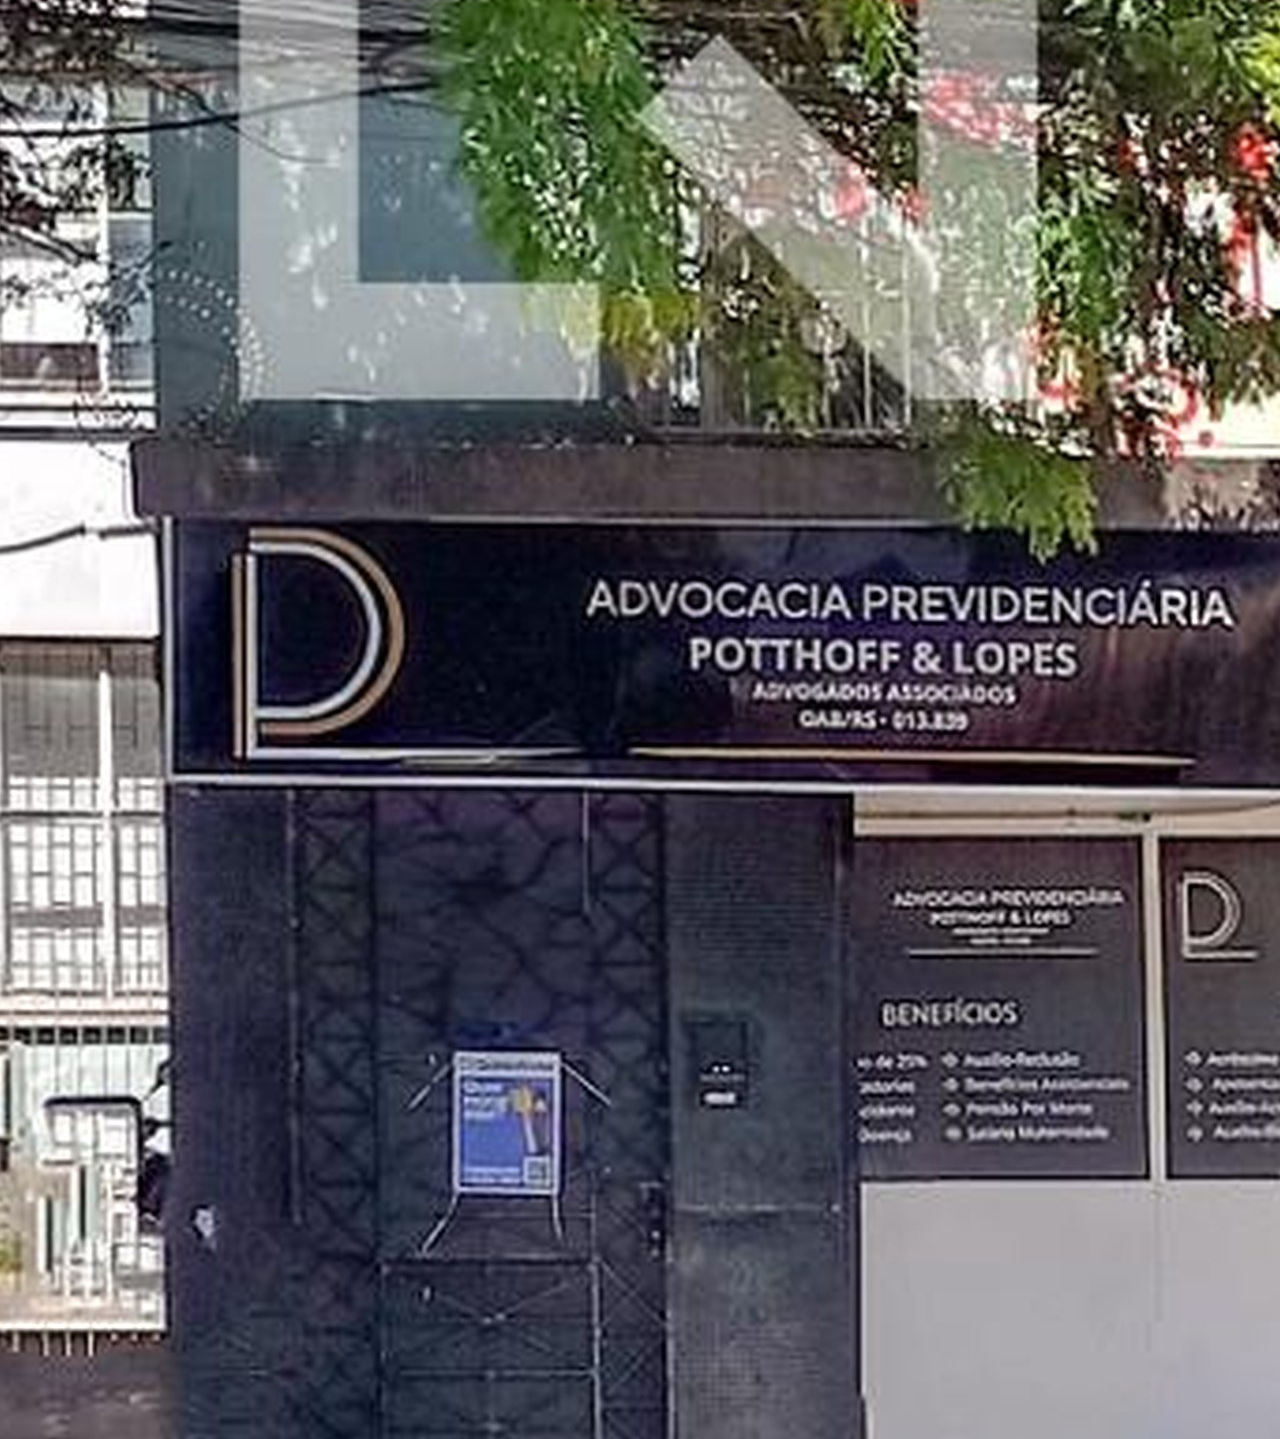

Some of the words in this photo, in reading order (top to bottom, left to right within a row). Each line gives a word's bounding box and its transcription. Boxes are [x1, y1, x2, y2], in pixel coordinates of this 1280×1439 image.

[586, 580, 853, 620] ADVOCACIA
[863, 577, 1236, 630] PREVIDENCIÁRIA
[689, 637, 901, 673] POTTHOFF
[912, 641, 942, 674] &
[953, 636, 1077, 676] LOPES
[882, 997, 1018, 1027] BENEFÍCIOS
